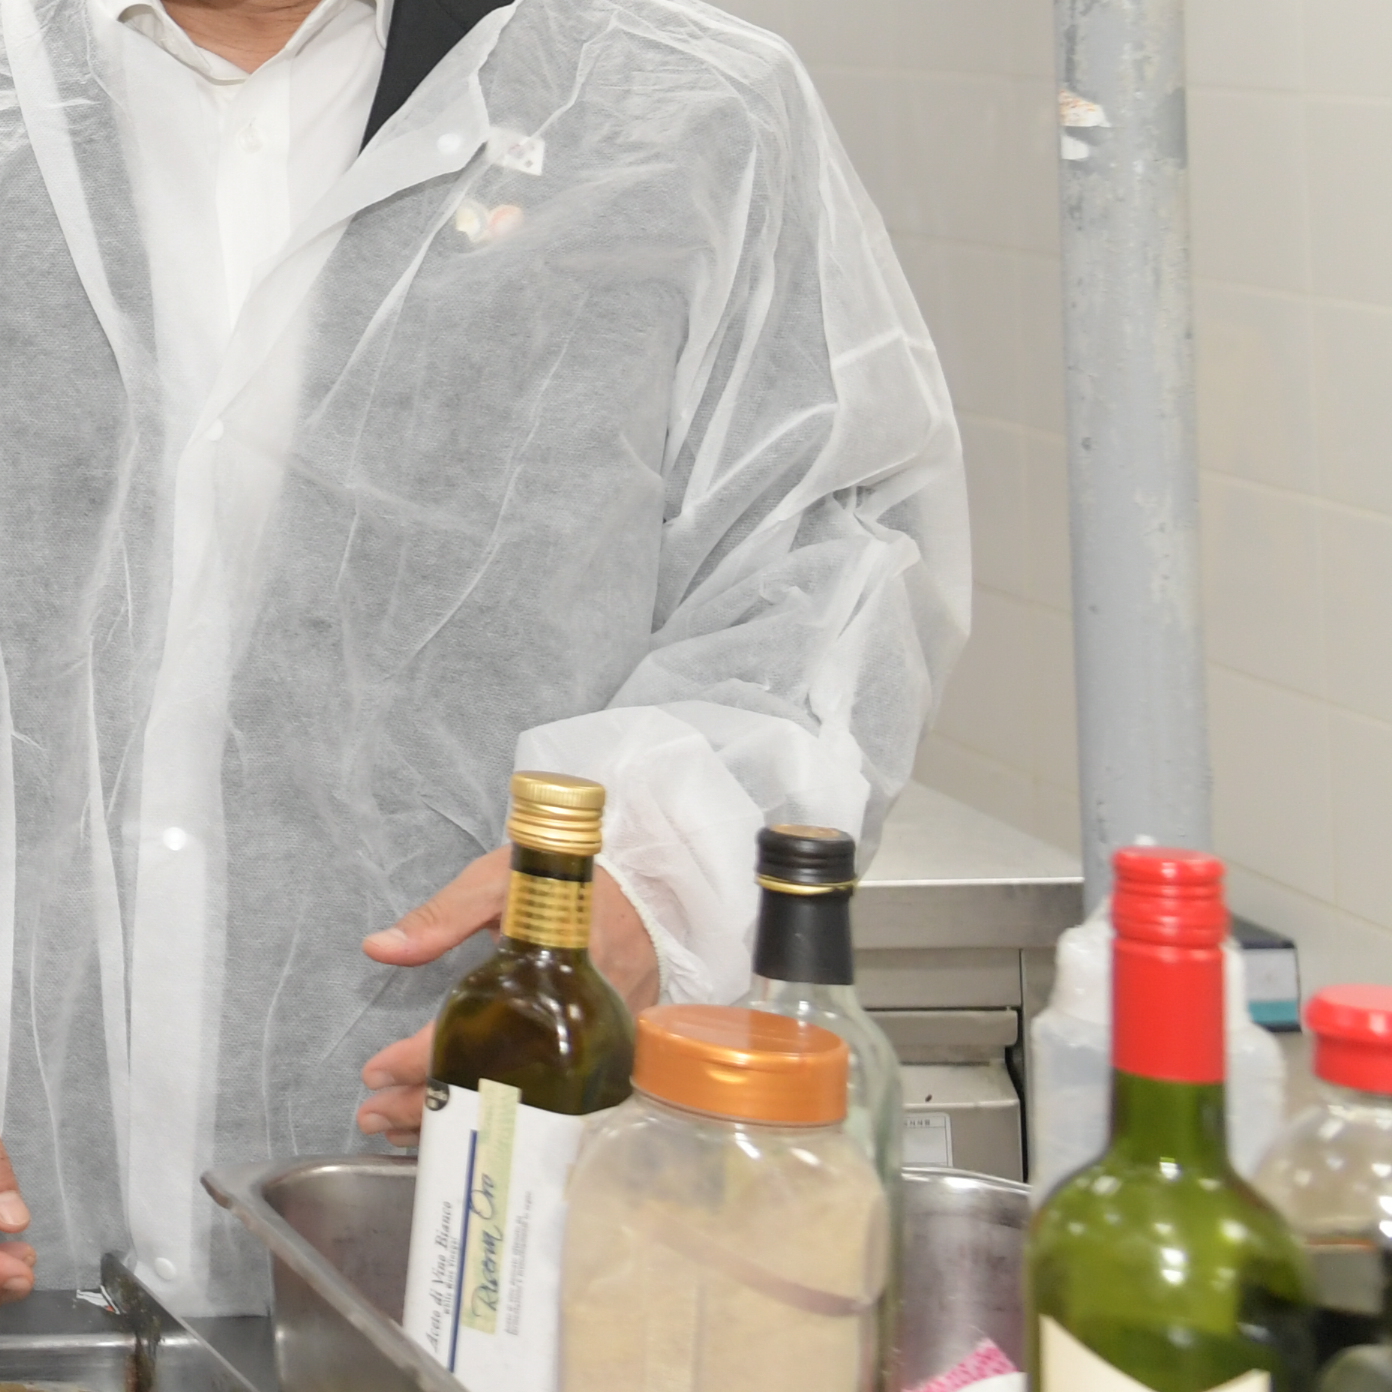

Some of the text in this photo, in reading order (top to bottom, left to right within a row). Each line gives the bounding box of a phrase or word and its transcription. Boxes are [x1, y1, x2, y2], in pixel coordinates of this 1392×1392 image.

[471, 1173, 496, 1221] Oro
[425, 1201, 452, 1353] Aceto di Vino Bianco
